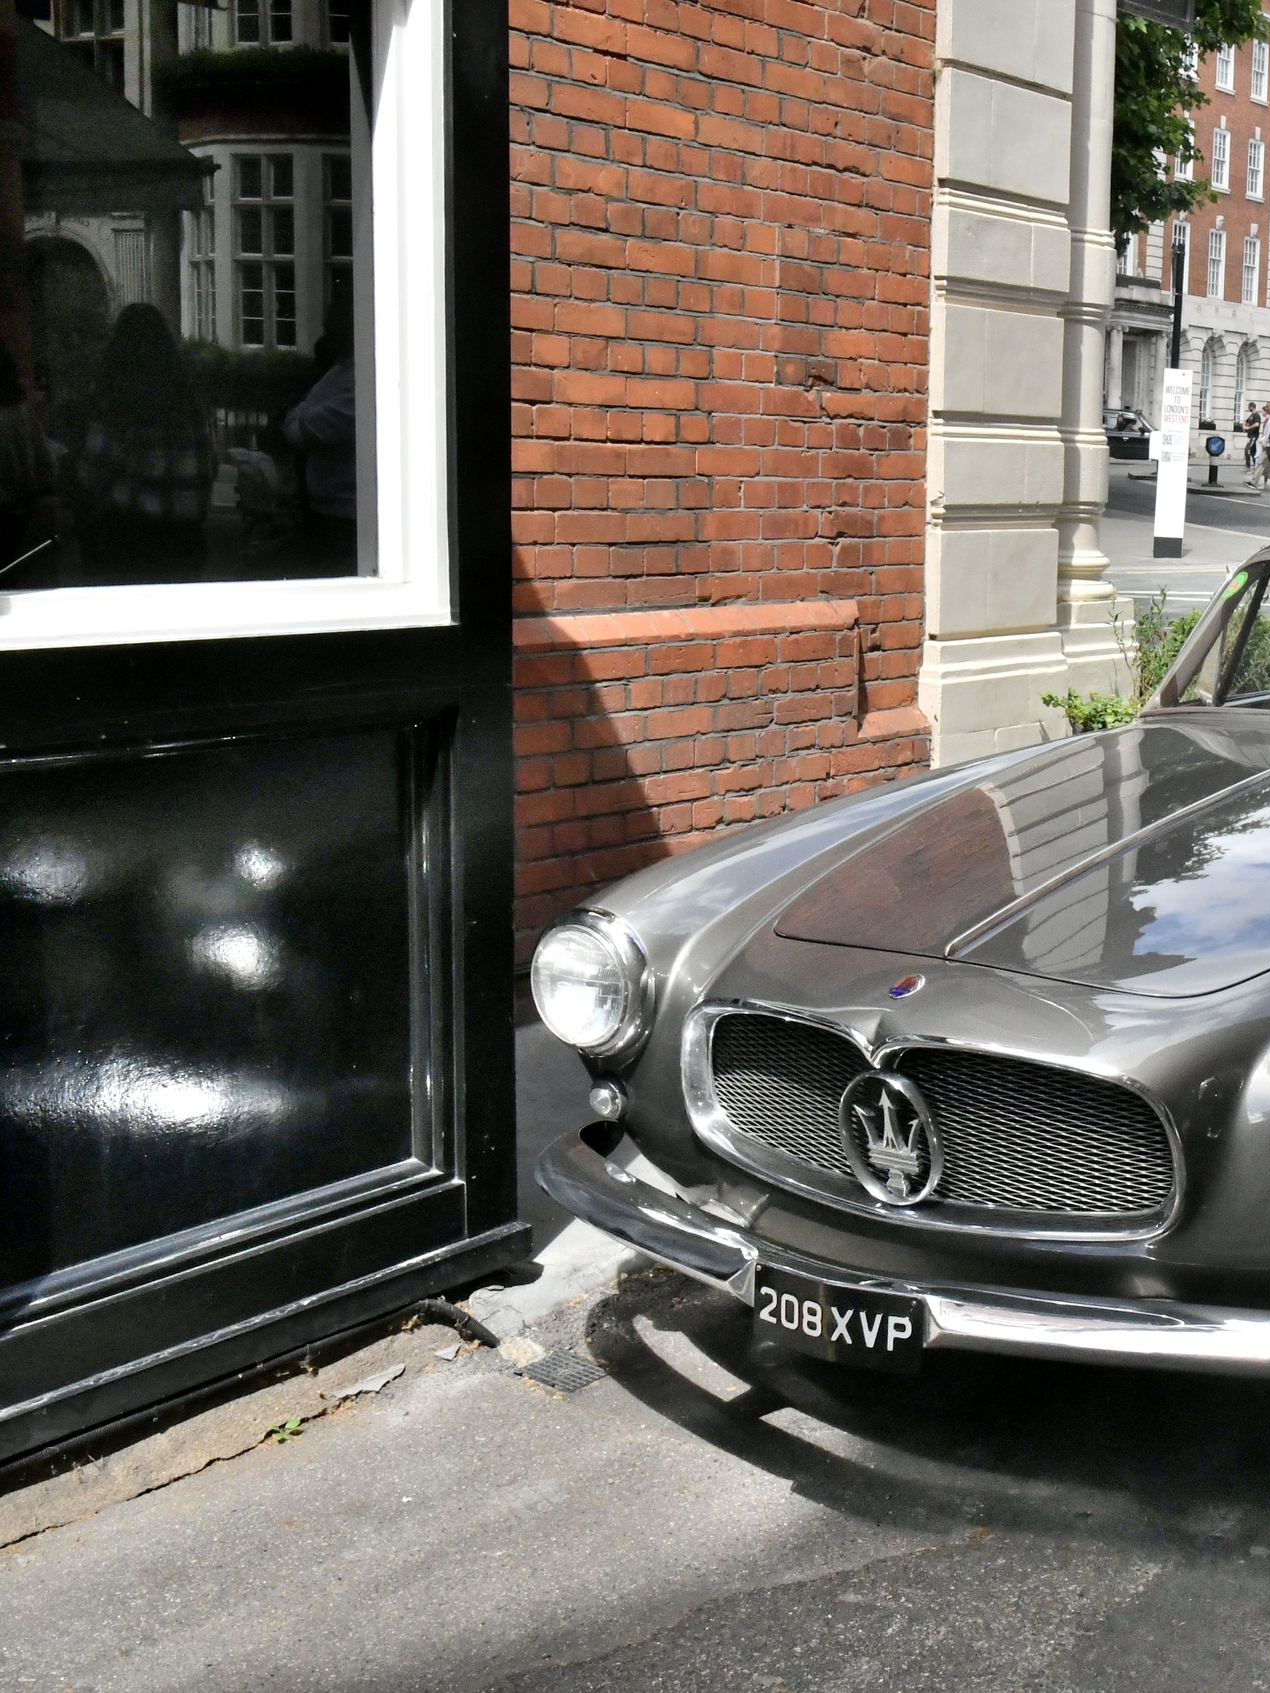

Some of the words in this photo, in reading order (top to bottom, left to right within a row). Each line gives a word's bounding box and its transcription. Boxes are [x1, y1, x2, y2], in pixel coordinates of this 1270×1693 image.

[1165, 385, 1190, 395] WELCOME
[1174, 395, 1181, 404] TO
[1164, 405, 1189, 414] LONDON'S
[1164, 414, 1178, 423] WEST
[1178, 415, 1188, 423] END
[759, 1286, 823, 1338] 208
[830, 1306, 913, 1352] XVP
